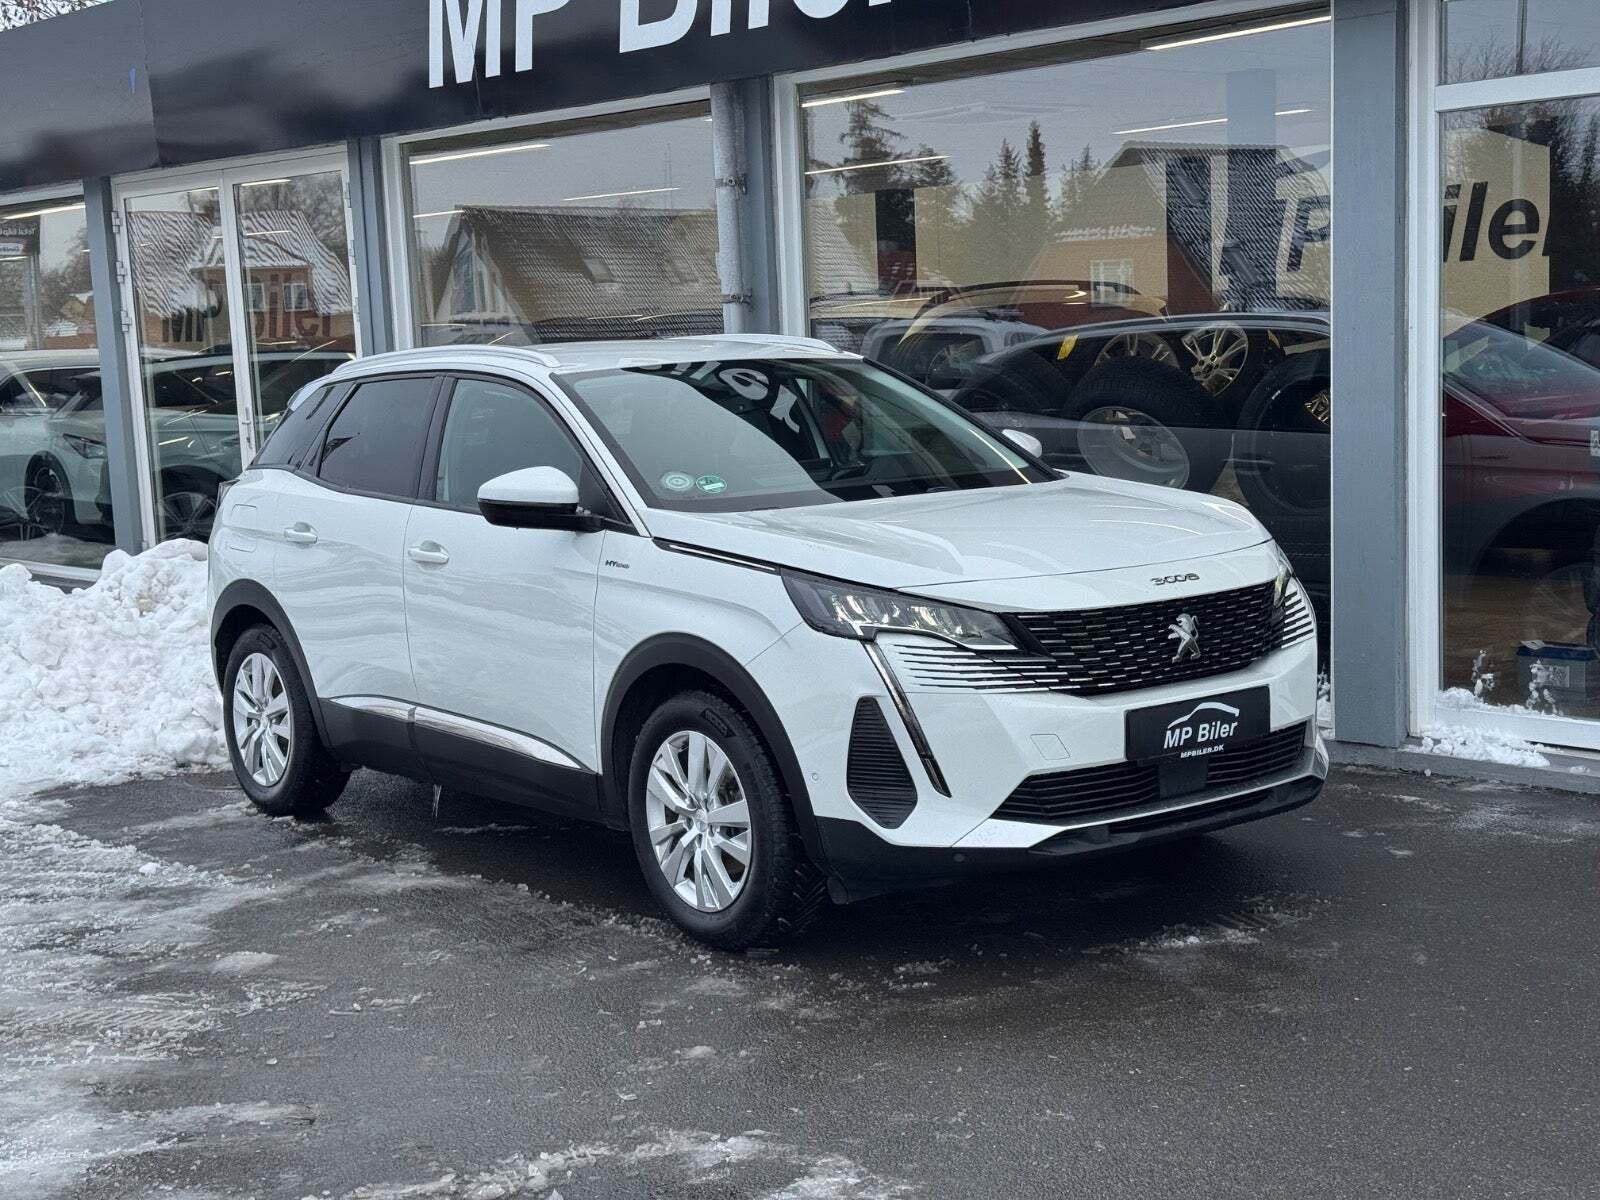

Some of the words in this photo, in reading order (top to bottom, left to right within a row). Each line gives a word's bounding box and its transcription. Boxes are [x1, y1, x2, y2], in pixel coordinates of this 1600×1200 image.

[1164, 726, 1192, 749] MP
[1197, 721, 1238, 743] Biler
[1180, 744, 1225, 759] MPBILER.DK
